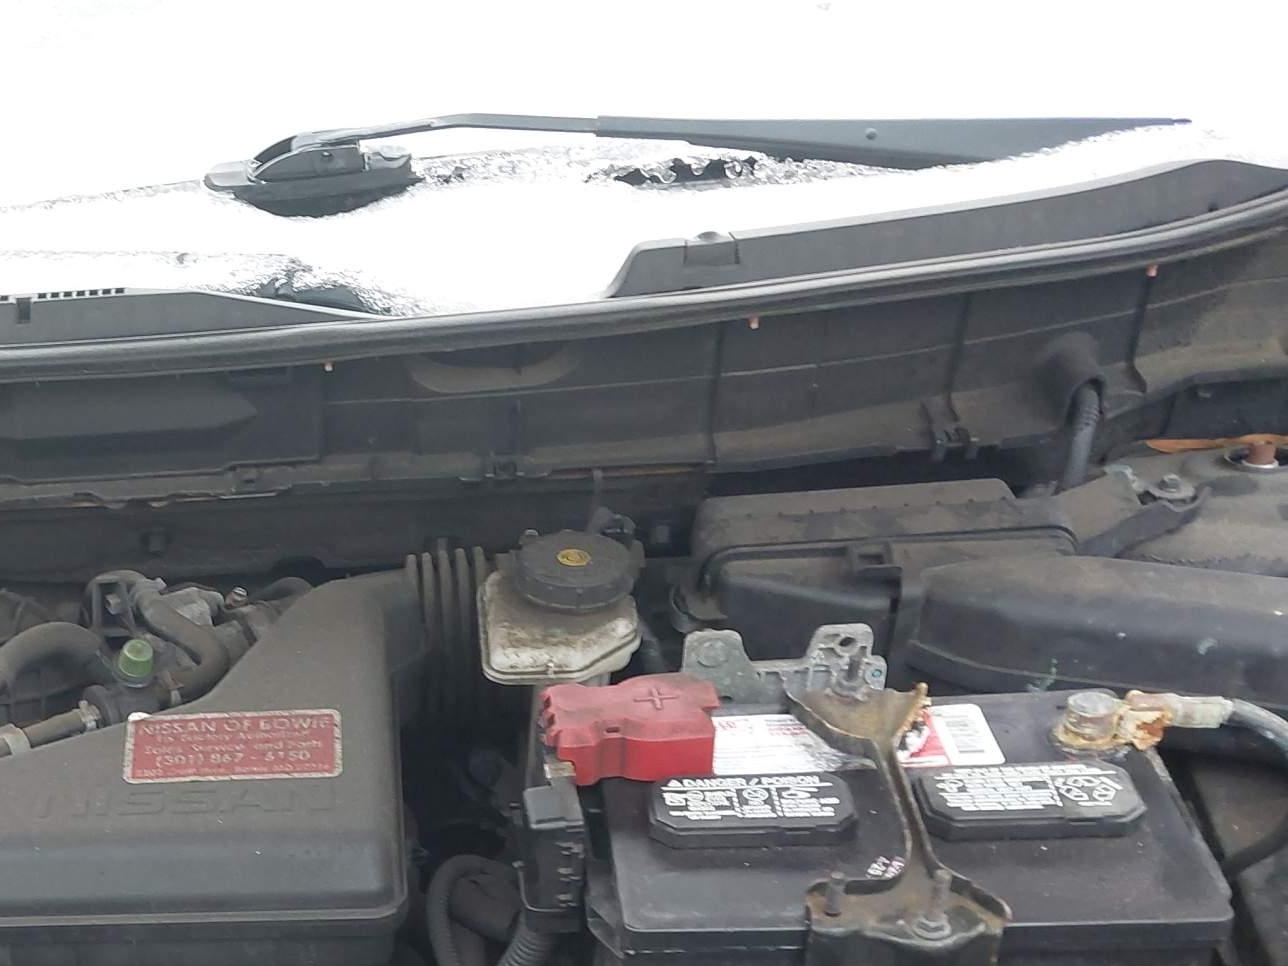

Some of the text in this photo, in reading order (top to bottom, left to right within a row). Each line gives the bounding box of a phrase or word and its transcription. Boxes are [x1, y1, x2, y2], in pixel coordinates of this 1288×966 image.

[139, 717, 331, 735] NISSAN OF BOWIE
[682, 777, 747, 787] DANGER
[762, 775, 820, 785] POISON
